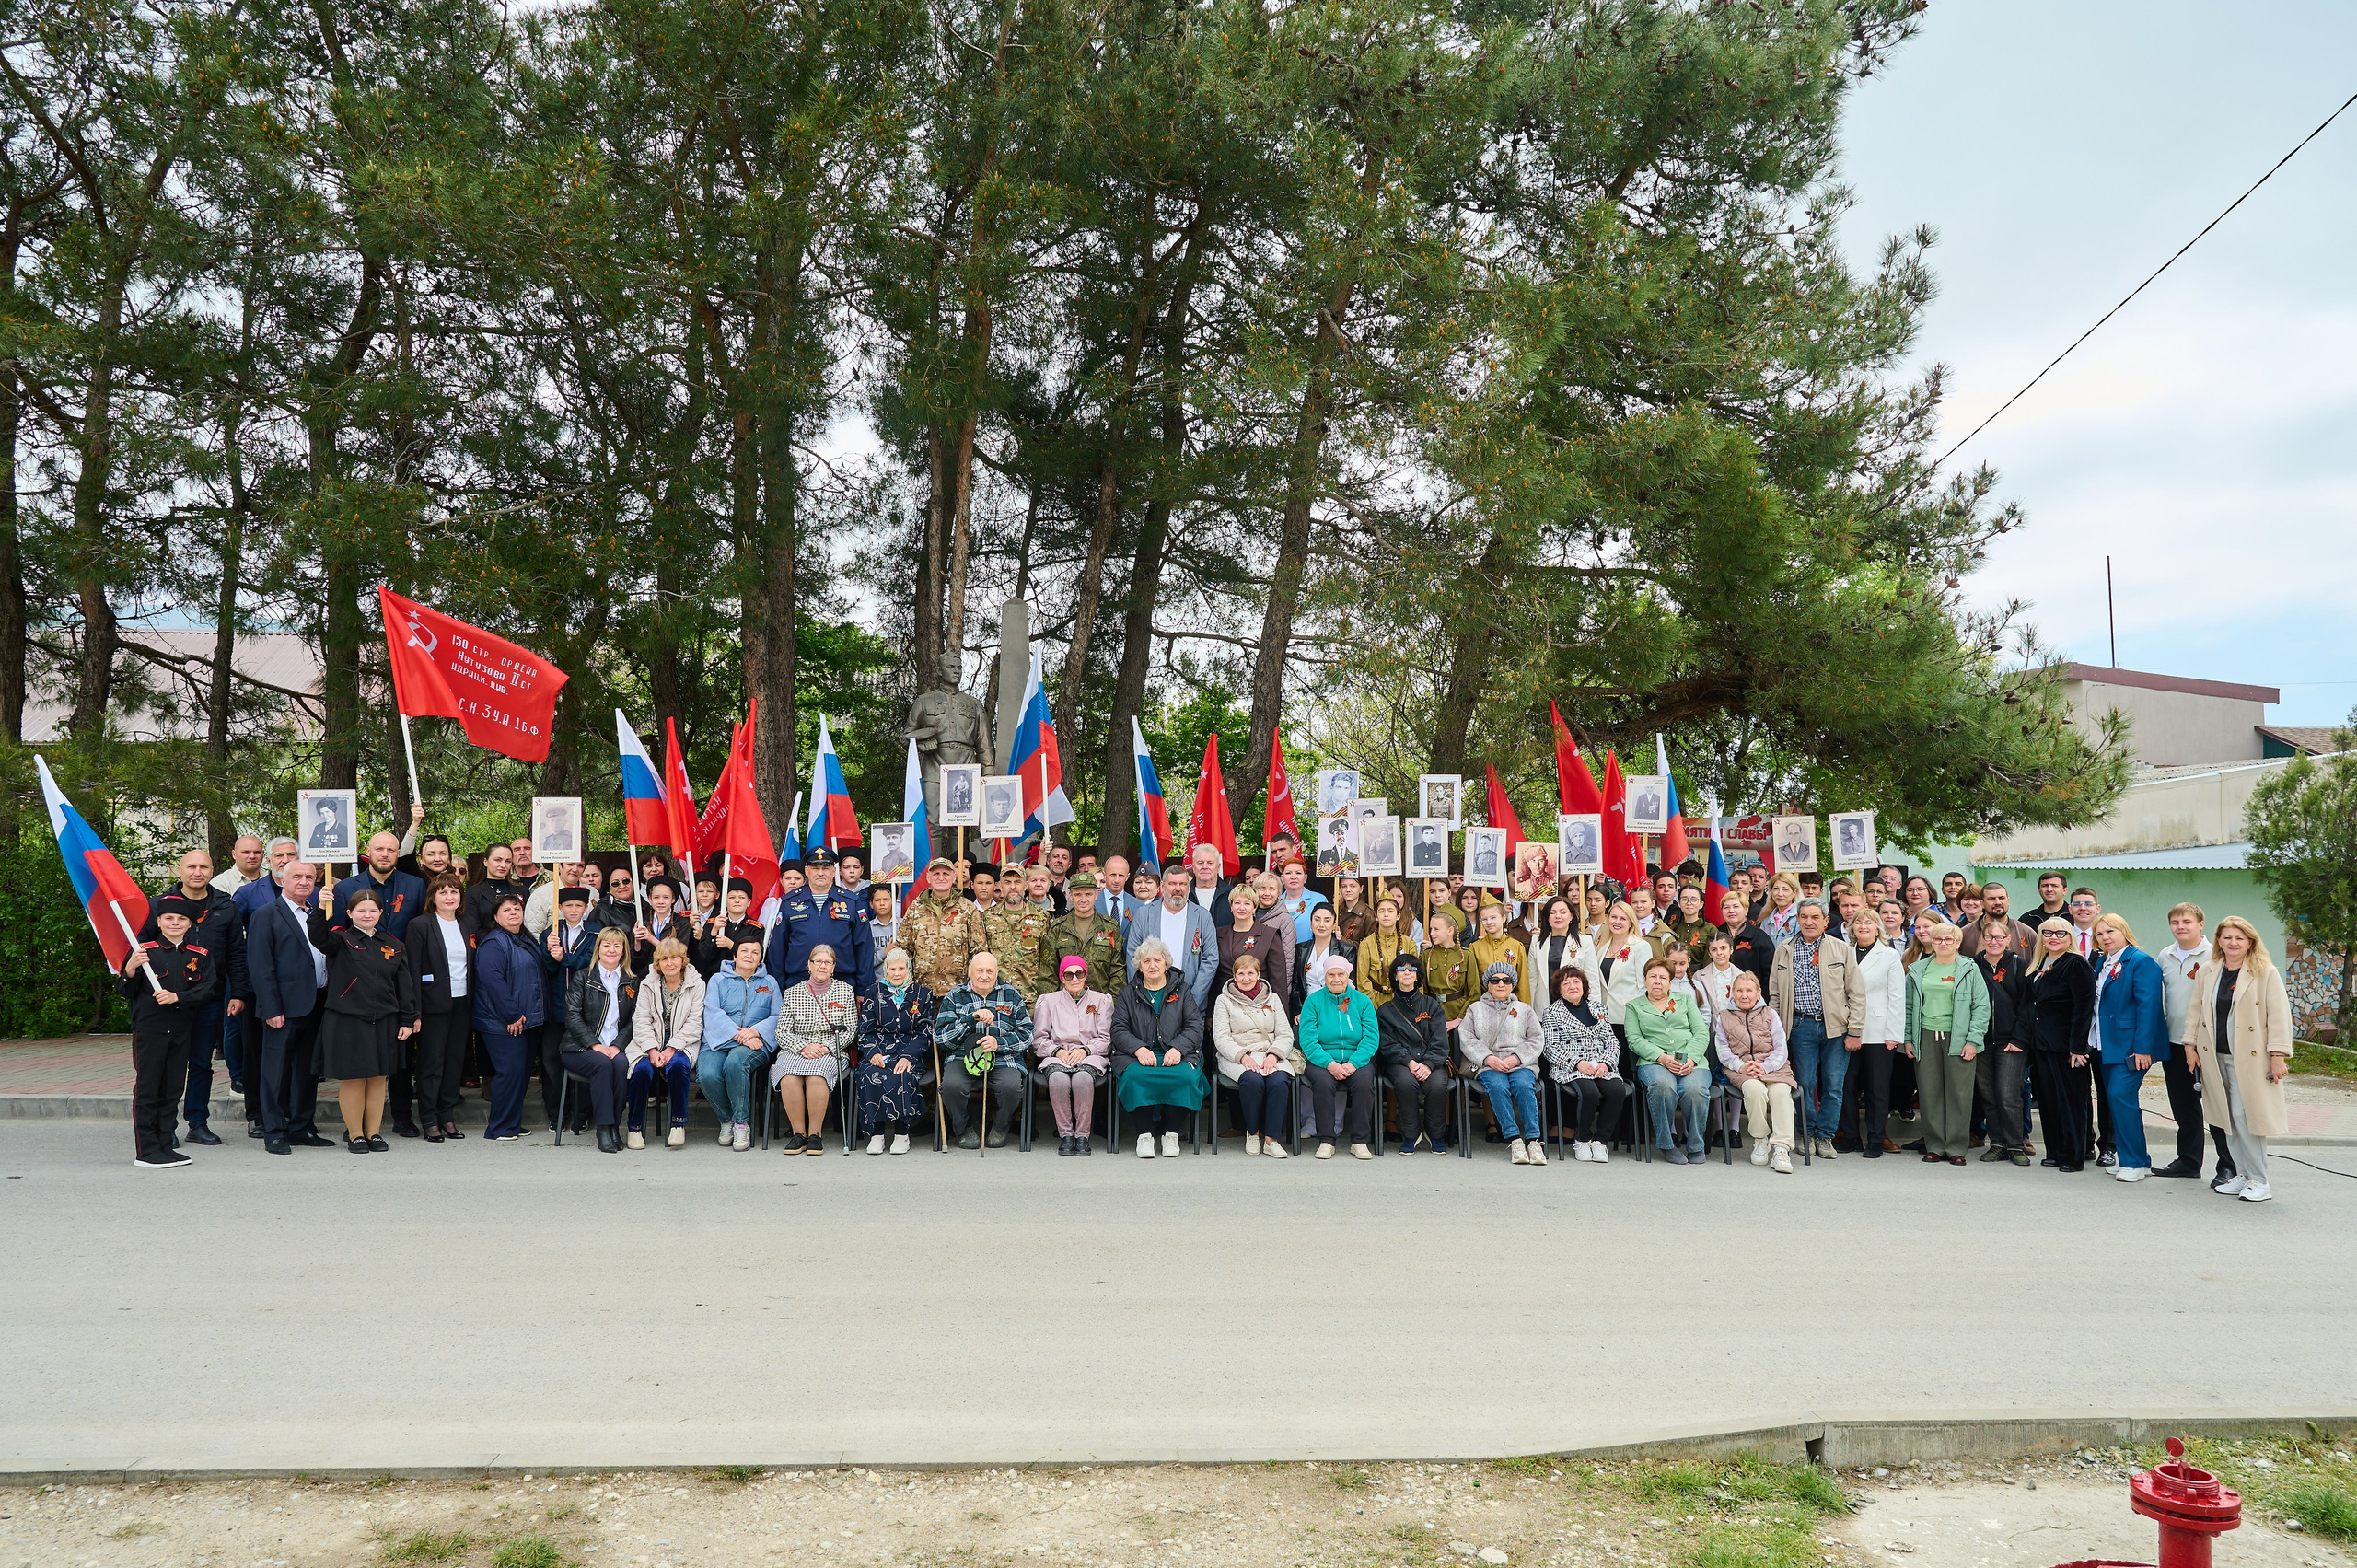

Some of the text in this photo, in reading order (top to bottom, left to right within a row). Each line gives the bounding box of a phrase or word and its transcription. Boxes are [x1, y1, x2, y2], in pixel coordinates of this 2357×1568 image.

[451, 634, 538, 678] 150 СТР. ОРДЕНА
[451, 662, 508, 696] ИДРИЦК. ДИВ.
[520, 680, 534, 692] СТ.
[1683, 826, 1712, 838] МЯТИ
[1727, 828, 1767, 840] СЛАВЫ
